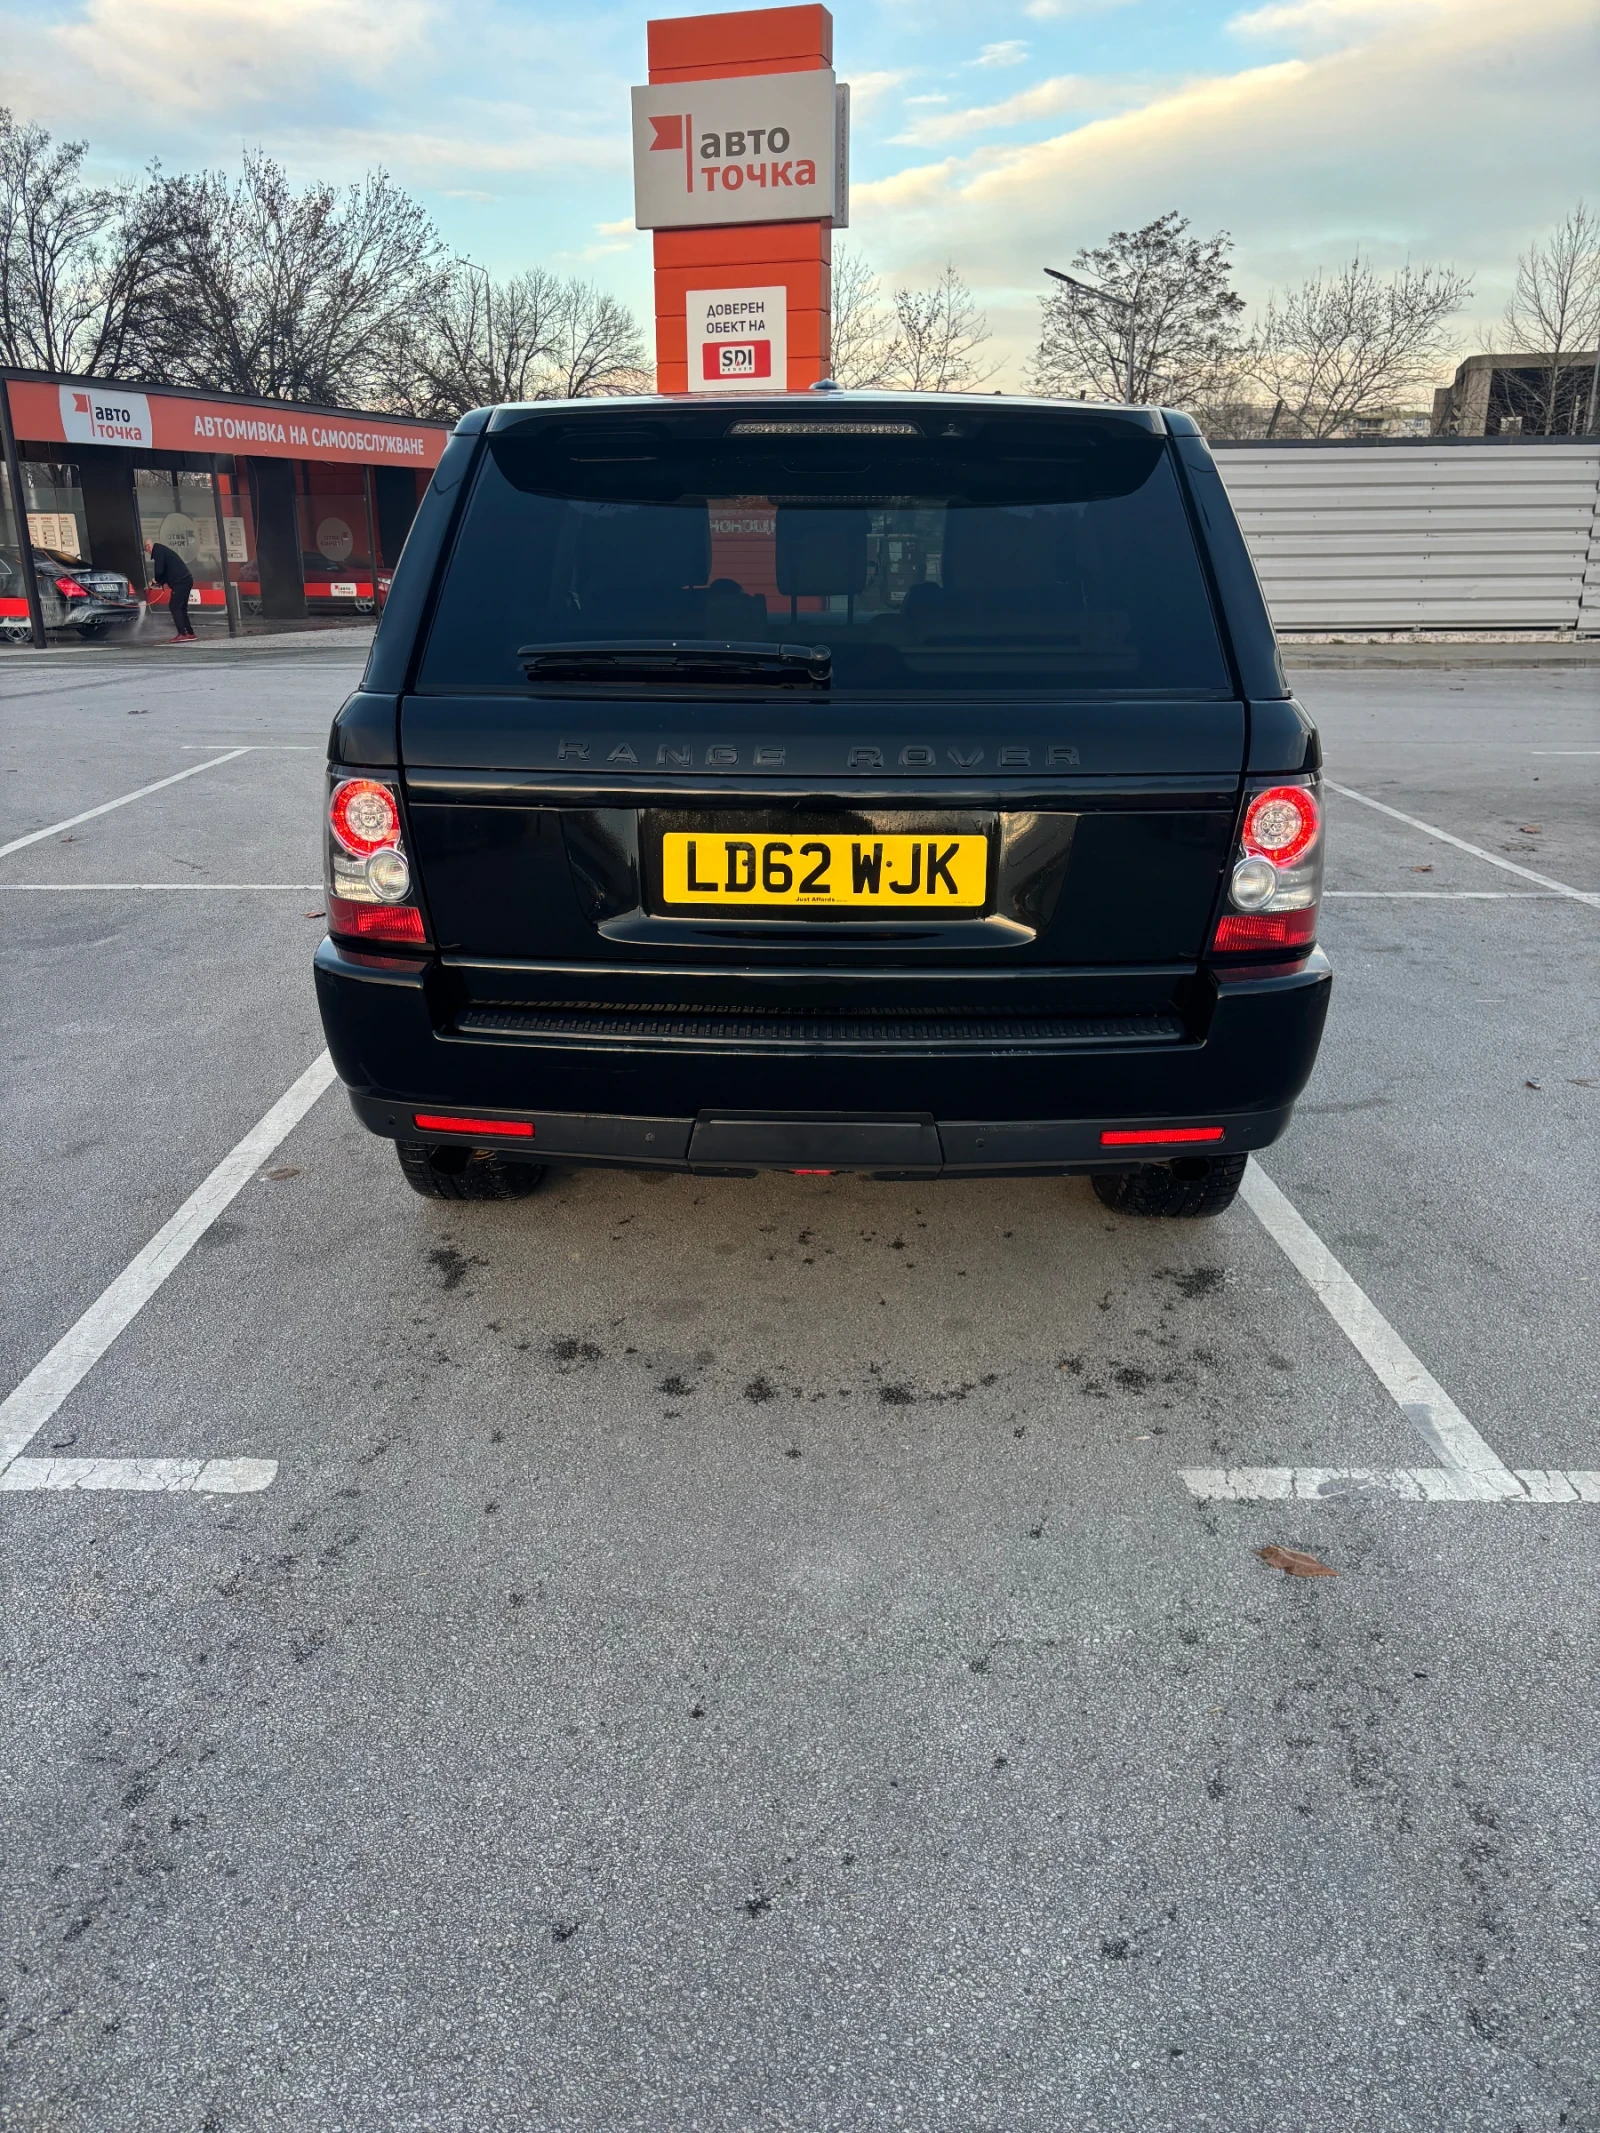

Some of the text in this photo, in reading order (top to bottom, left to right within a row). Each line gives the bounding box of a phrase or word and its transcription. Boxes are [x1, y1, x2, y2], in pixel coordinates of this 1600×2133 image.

[700, 126, 790, 159] авто
[701, 159, 816, 192] точка
[706, 301, 765, 318] ДОВЕРЕН
[706, 319, 766, 334] ОБЕКТ НА
[722, 349, 752, 367] SDI
[95, 406, 131, 423] авто
[97, 424, 142, 441] точка
[194, 415, 424, 456] АВТОМИВКА НА САМООБСЛУЖВАНЕ
[557, 739, 1080, 768] RANGE ROVER
[687, 841, 960, 895] LD62 WJK
